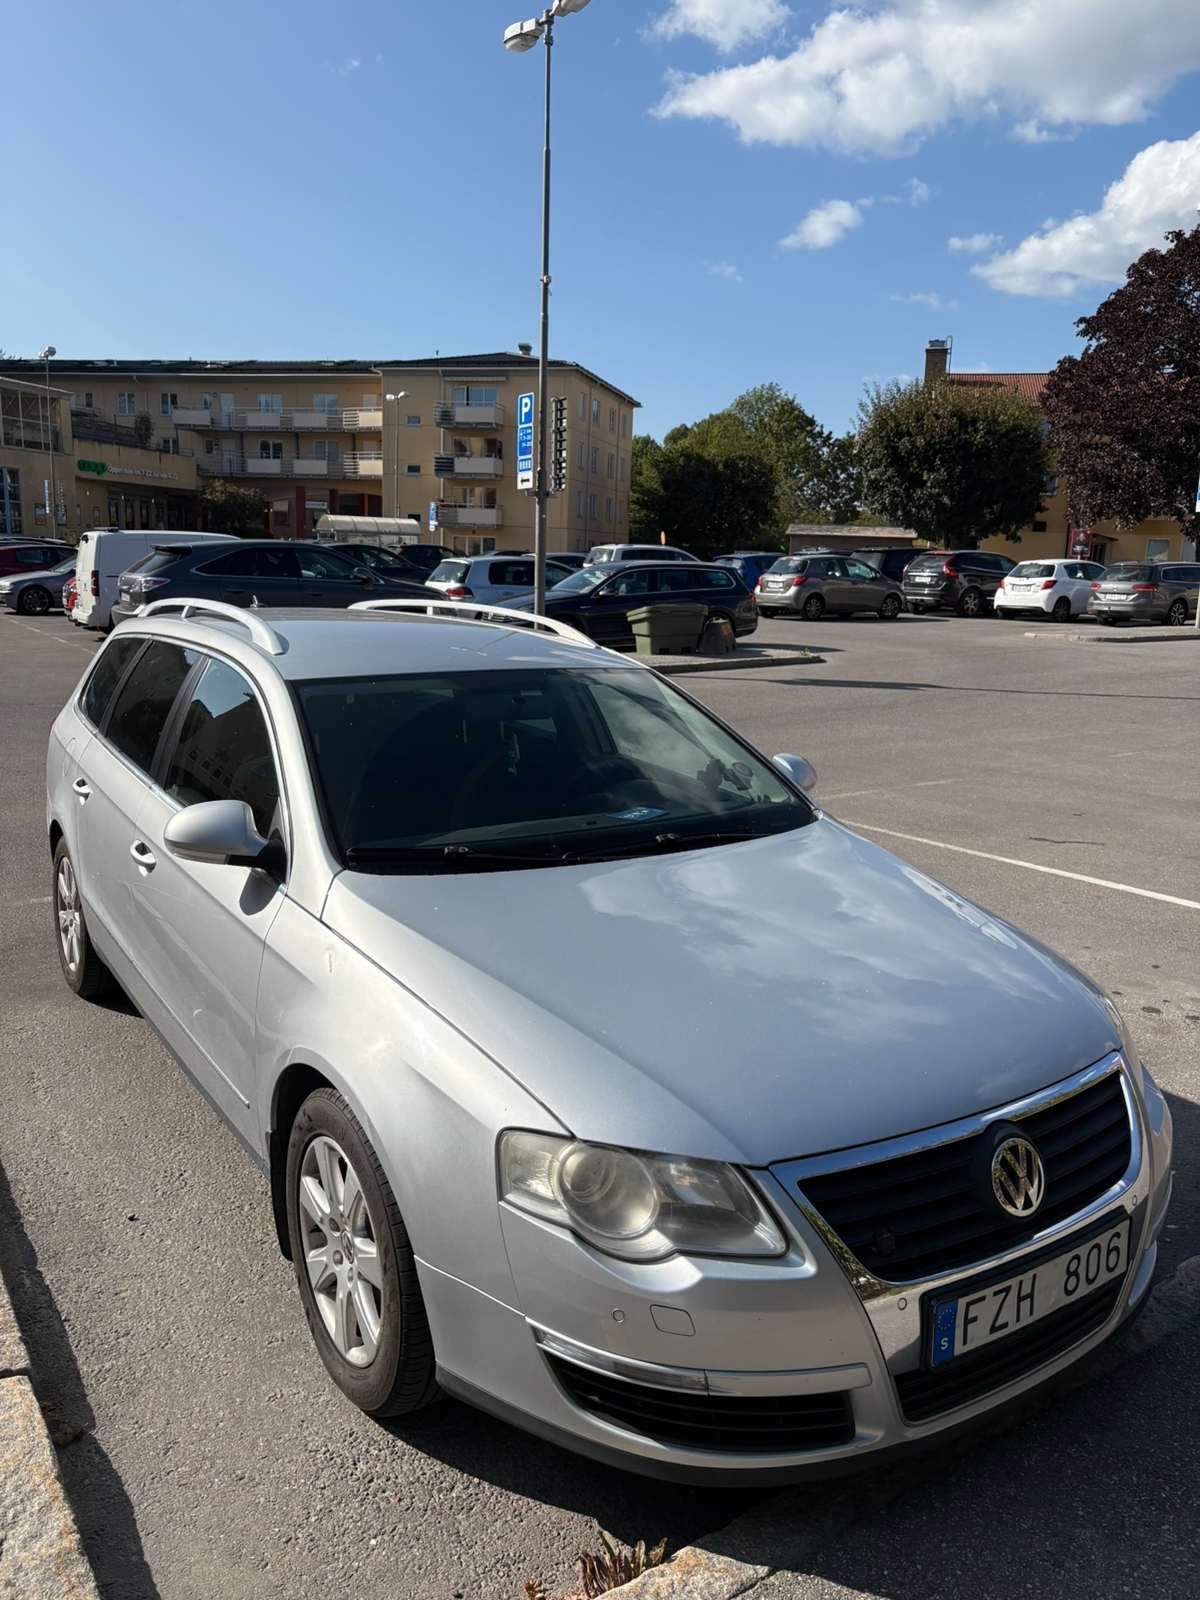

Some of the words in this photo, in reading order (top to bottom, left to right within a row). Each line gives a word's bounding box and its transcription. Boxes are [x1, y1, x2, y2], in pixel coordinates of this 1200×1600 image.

[522, 397, 531, 423] P
[78, 460, 107, 475] coop
[962, 1273, 1037, 1346] FZH
[1063, 1231, 1122, 1297] 806
[940, 1336, 949, 1351] S
